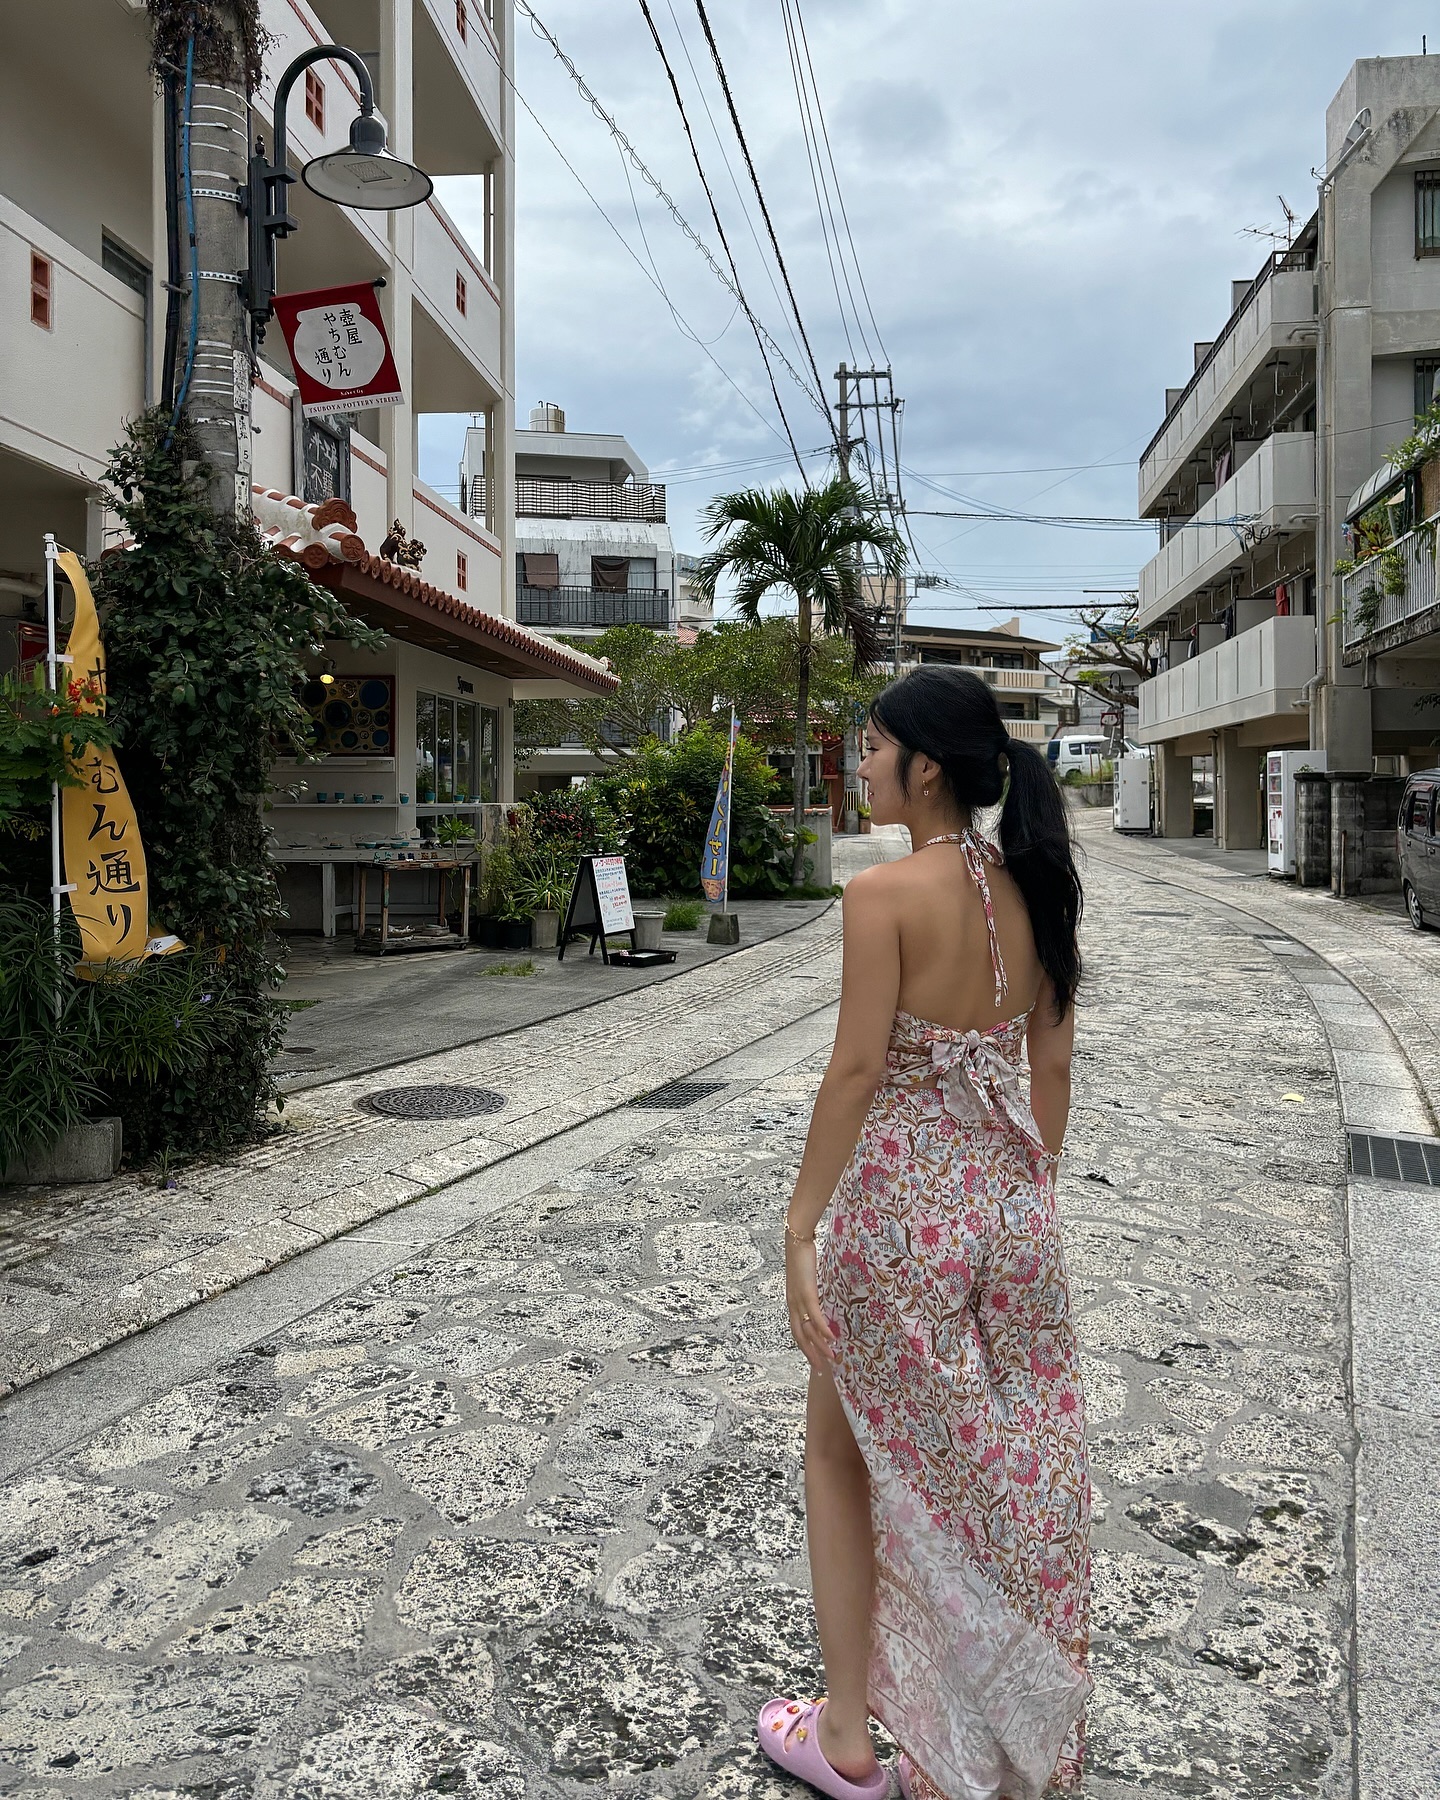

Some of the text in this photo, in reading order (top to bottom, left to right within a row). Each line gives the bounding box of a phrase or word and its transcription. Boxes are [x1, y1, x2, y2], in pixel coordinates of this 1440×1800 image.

[323, 312, 351, 377] やちむん
[314, 347, 333, 384] 通り
[309, 395, 399, 414] TSUBOYA POTTERY STREET
[243, 450, 249, 460] 5
